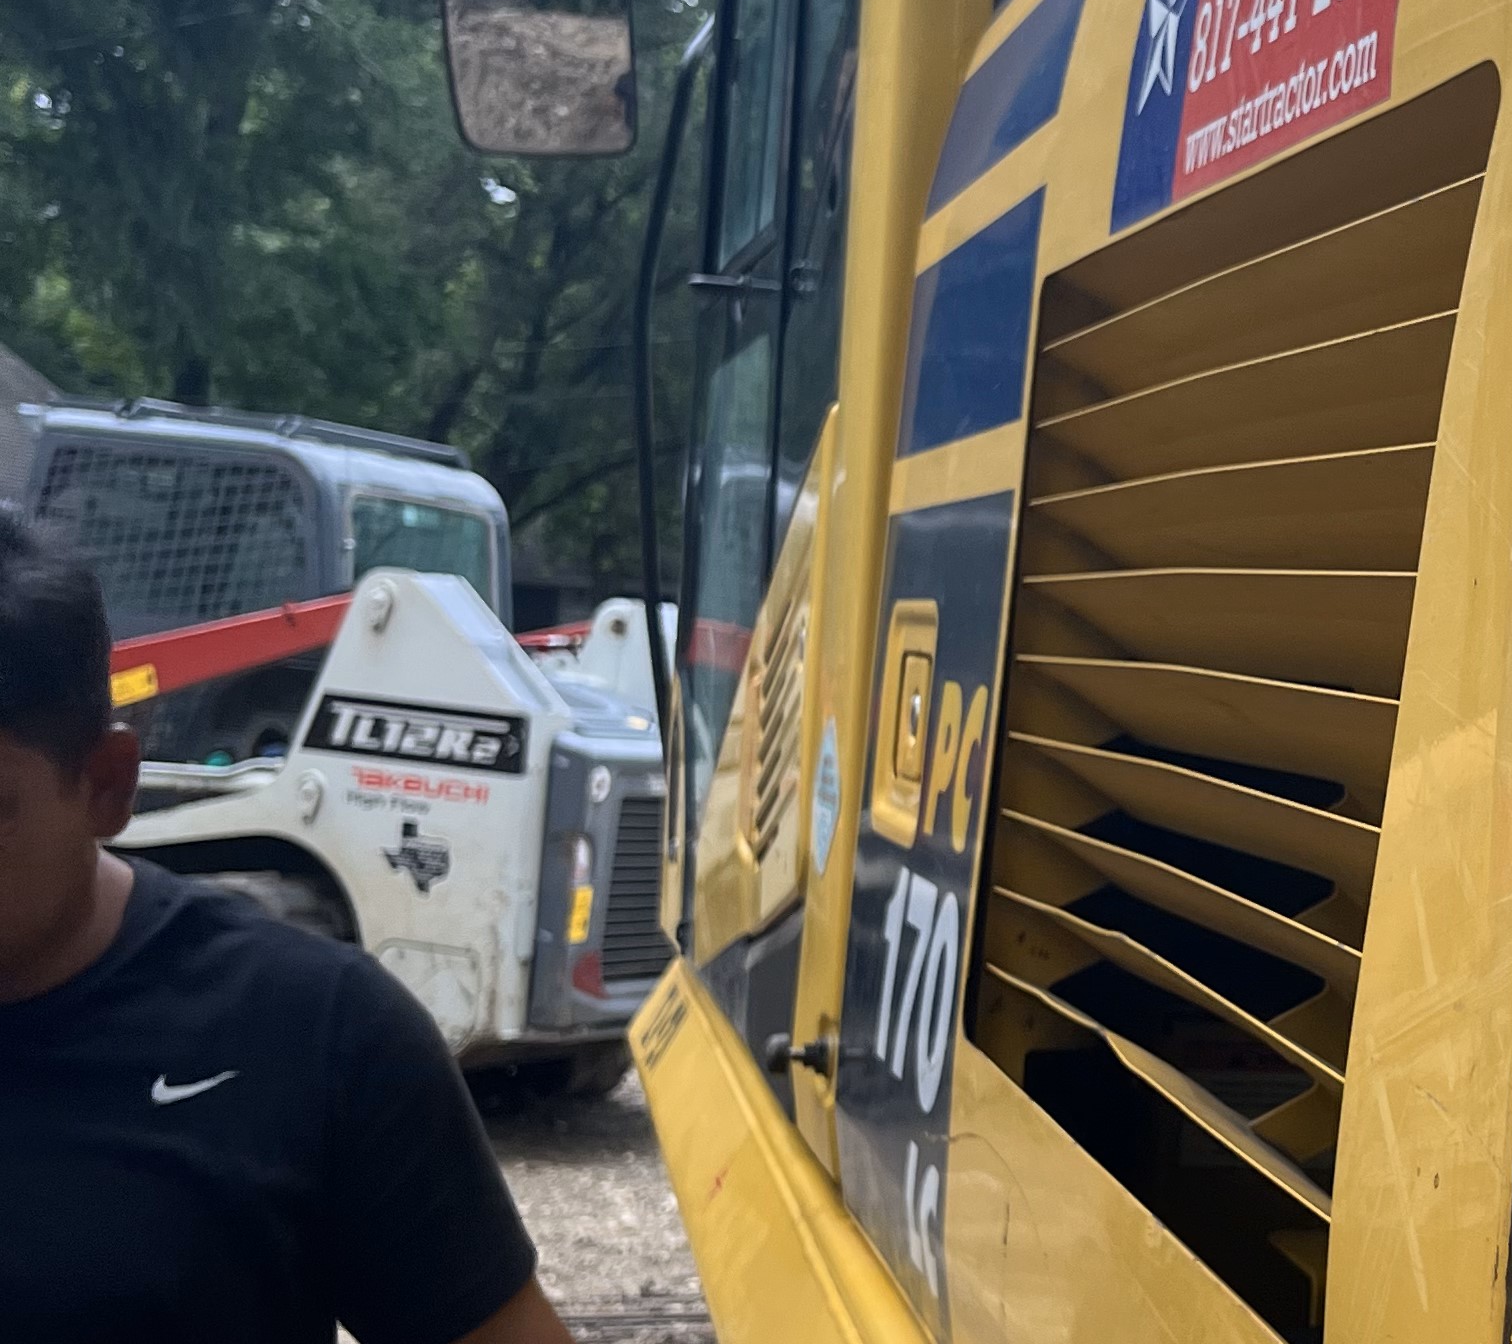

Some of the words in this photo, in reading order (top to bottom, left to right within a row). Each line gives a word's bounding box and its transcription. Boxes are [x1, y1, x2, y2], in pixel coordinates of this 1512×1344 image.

[1184, 30, 1377, 175] www.startractor.com
[923, 680, 988, 854] PC
[875, 866, 959, 1114] 170
